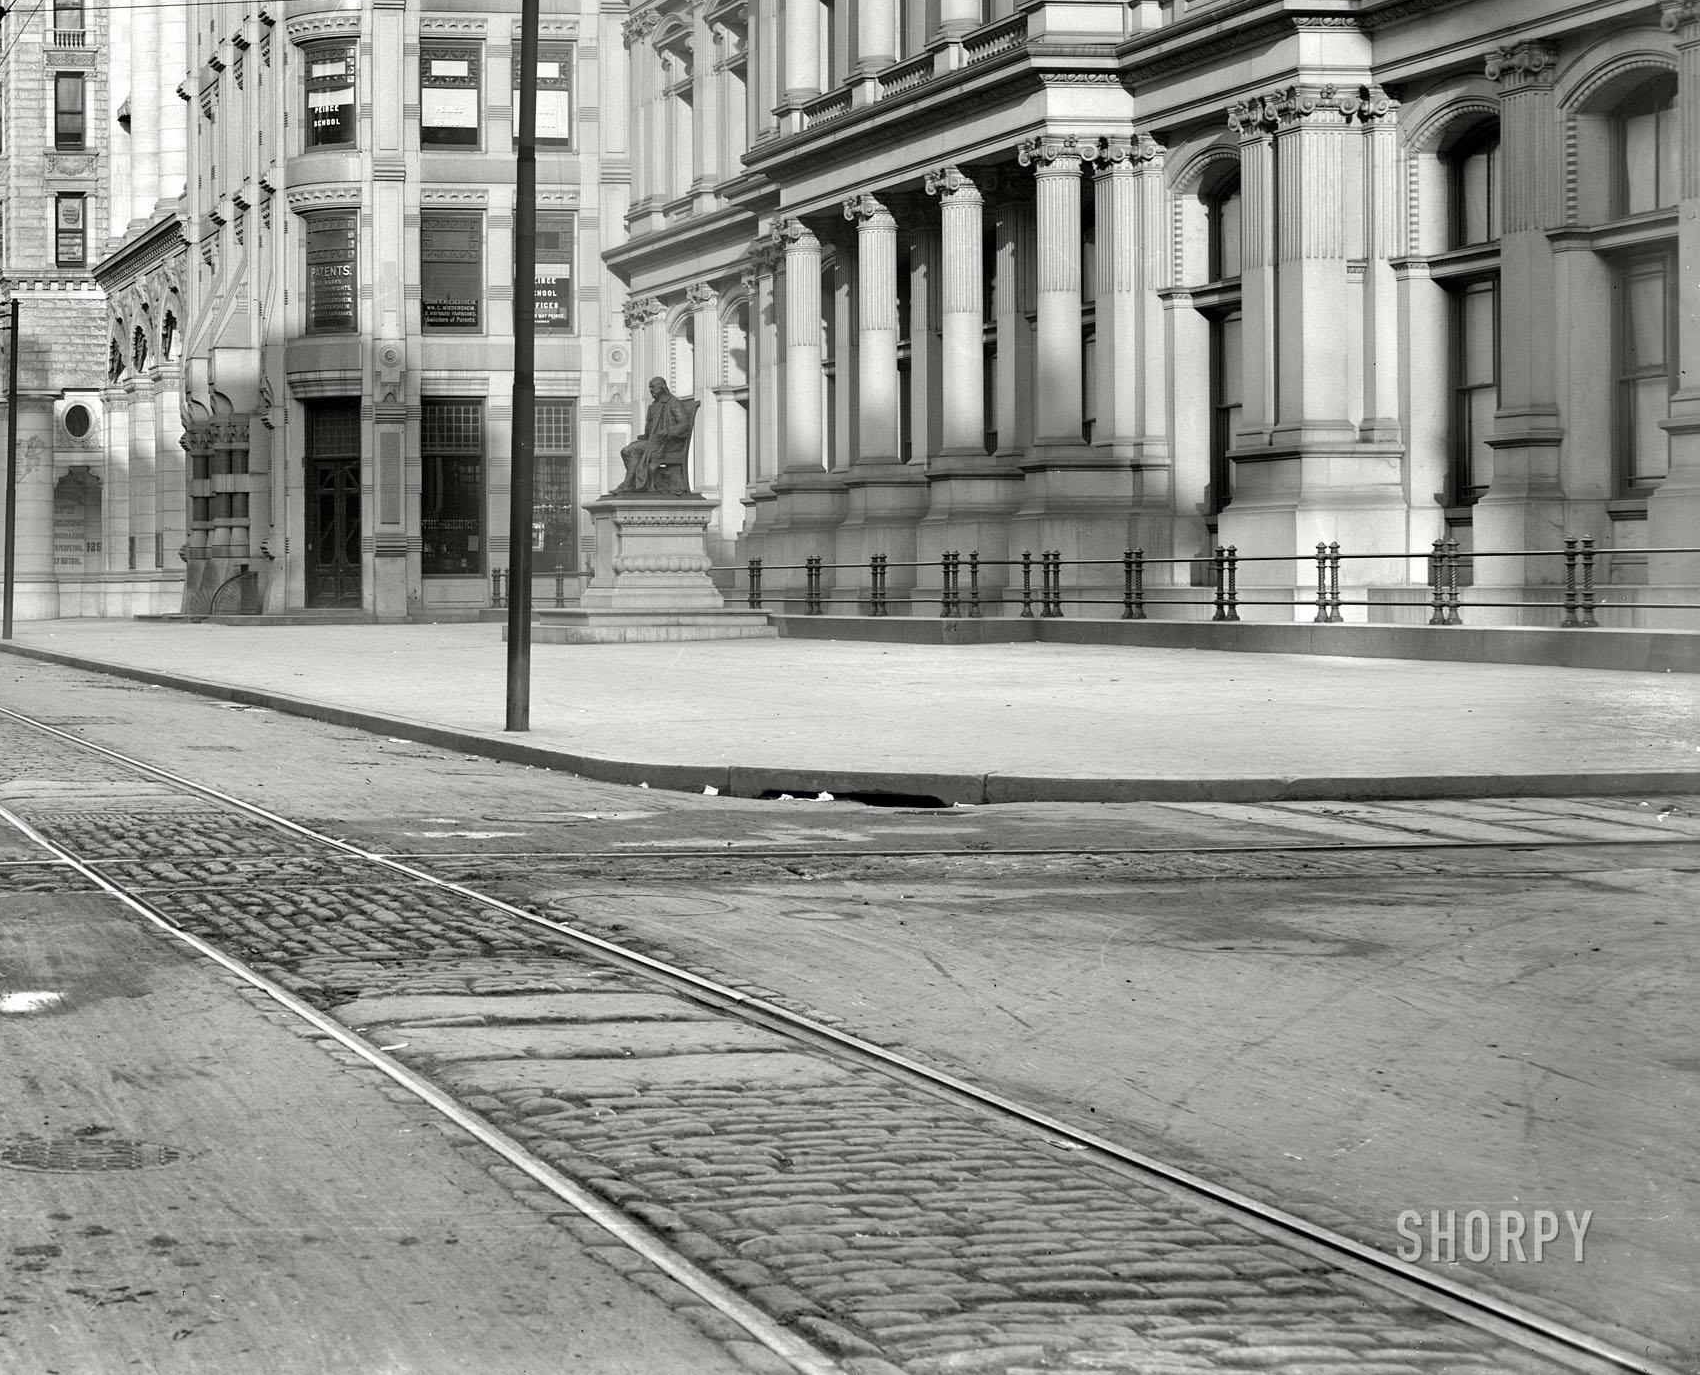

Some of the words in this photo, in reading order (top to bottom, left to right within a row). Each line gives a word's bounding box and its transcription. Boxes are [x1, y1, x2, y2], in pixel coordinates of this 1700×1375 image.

[314, 104, 340, 114] PEIRCE
[313, 118, 341, 127] SCHOOL
[311, 265, 353, 277] PATENTS.
